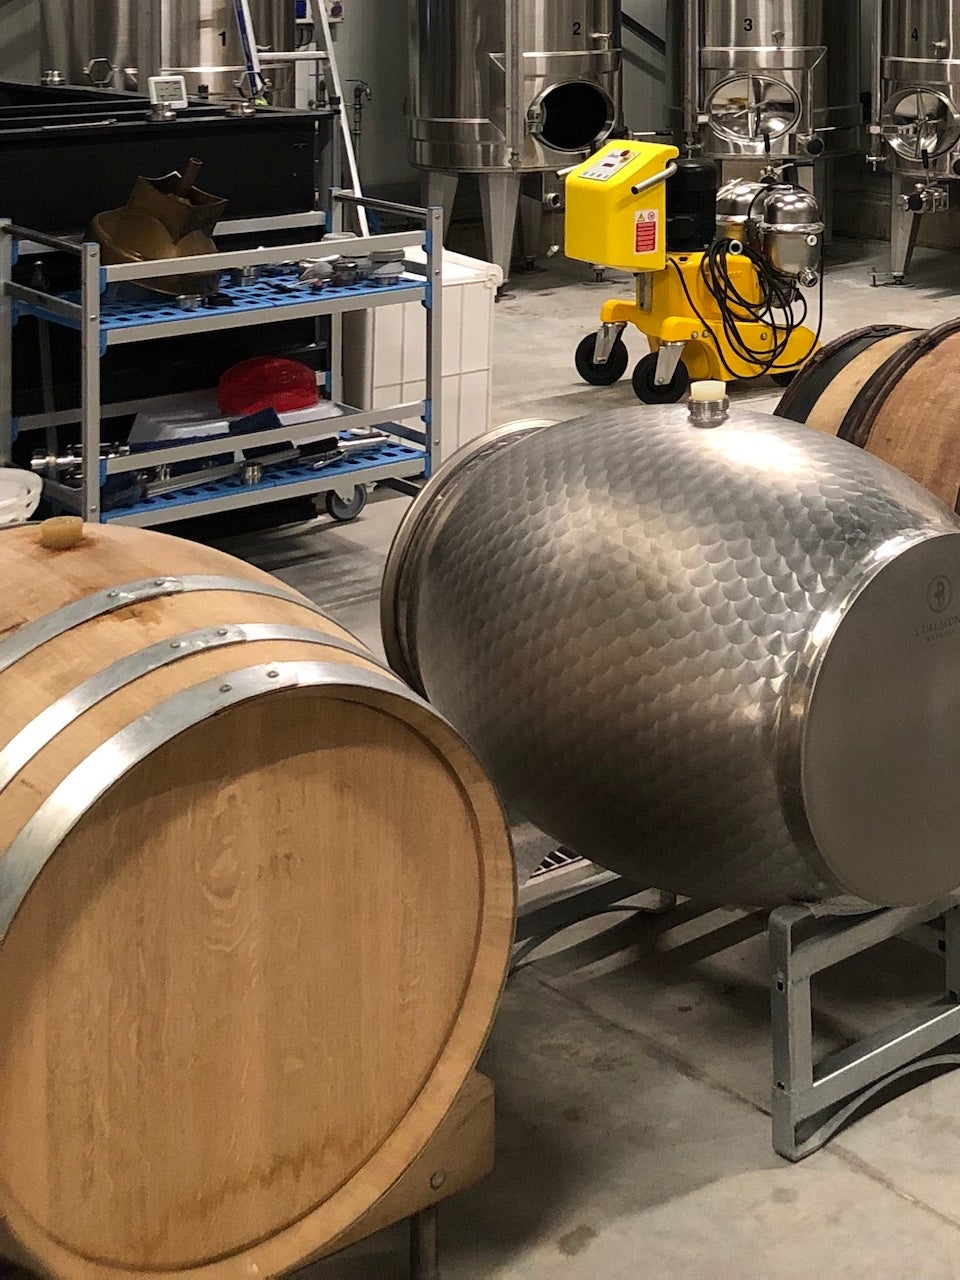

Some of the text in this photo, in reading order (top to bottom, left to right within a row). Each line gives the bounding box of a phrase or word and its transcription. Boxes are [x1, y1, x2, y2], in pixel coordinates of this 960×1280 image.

[572, 21, 581, 36] 2
[743, 18, 752, 32] 3
[218, 30, 227, 47] 1
[911, 27, 919, 42] 4
